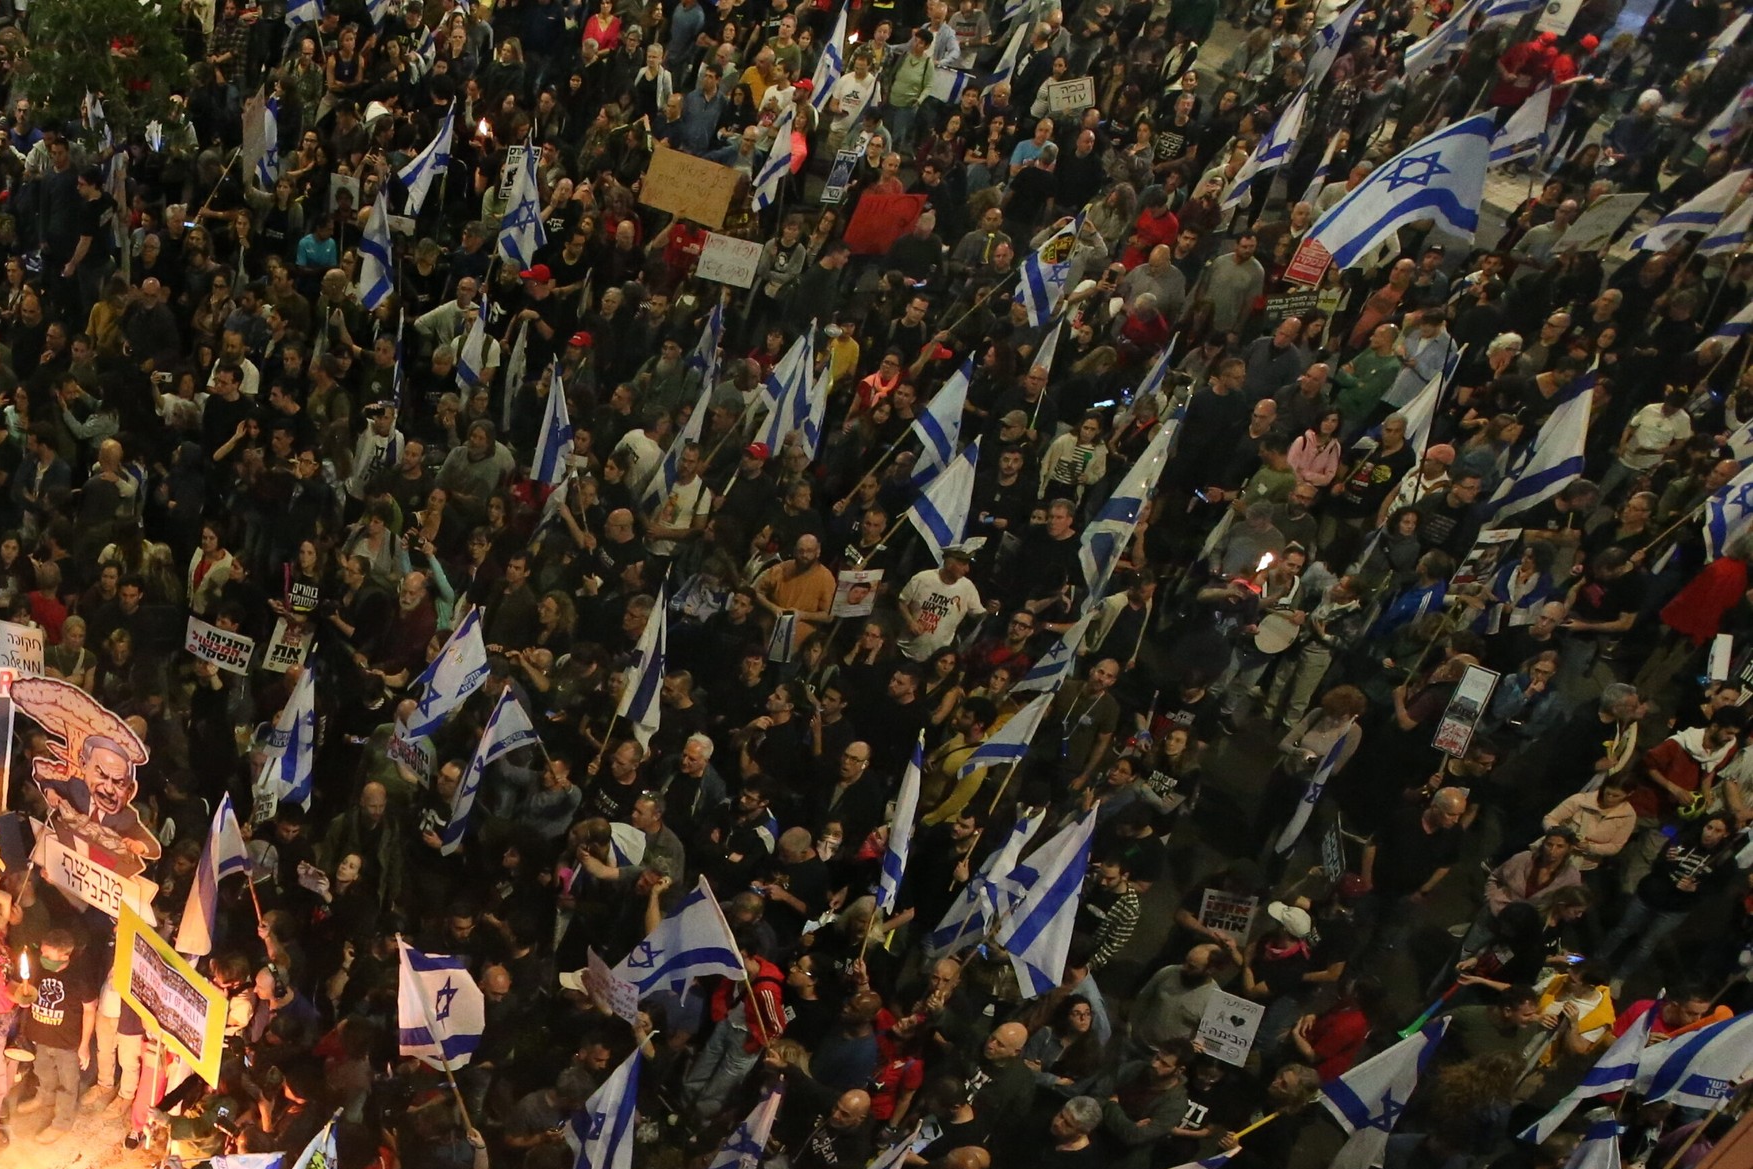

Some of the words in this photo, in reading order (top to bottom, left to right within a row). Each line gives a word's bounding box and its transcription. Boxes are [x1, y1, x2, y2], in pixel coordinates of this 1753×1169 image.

[193, 630, 240, 657] המכשול
[206, 630, 251, 652] נתניהו
[272, 643, 302, 659] את
[1, 652, 42, 673] ממשלה
[198, 643, 247, 669] לעסקה
[61, 849, 123, 898] מורשת
[63, 868, 121, 911] נתניהו
[31, 1002, 65, 1018] חובה
